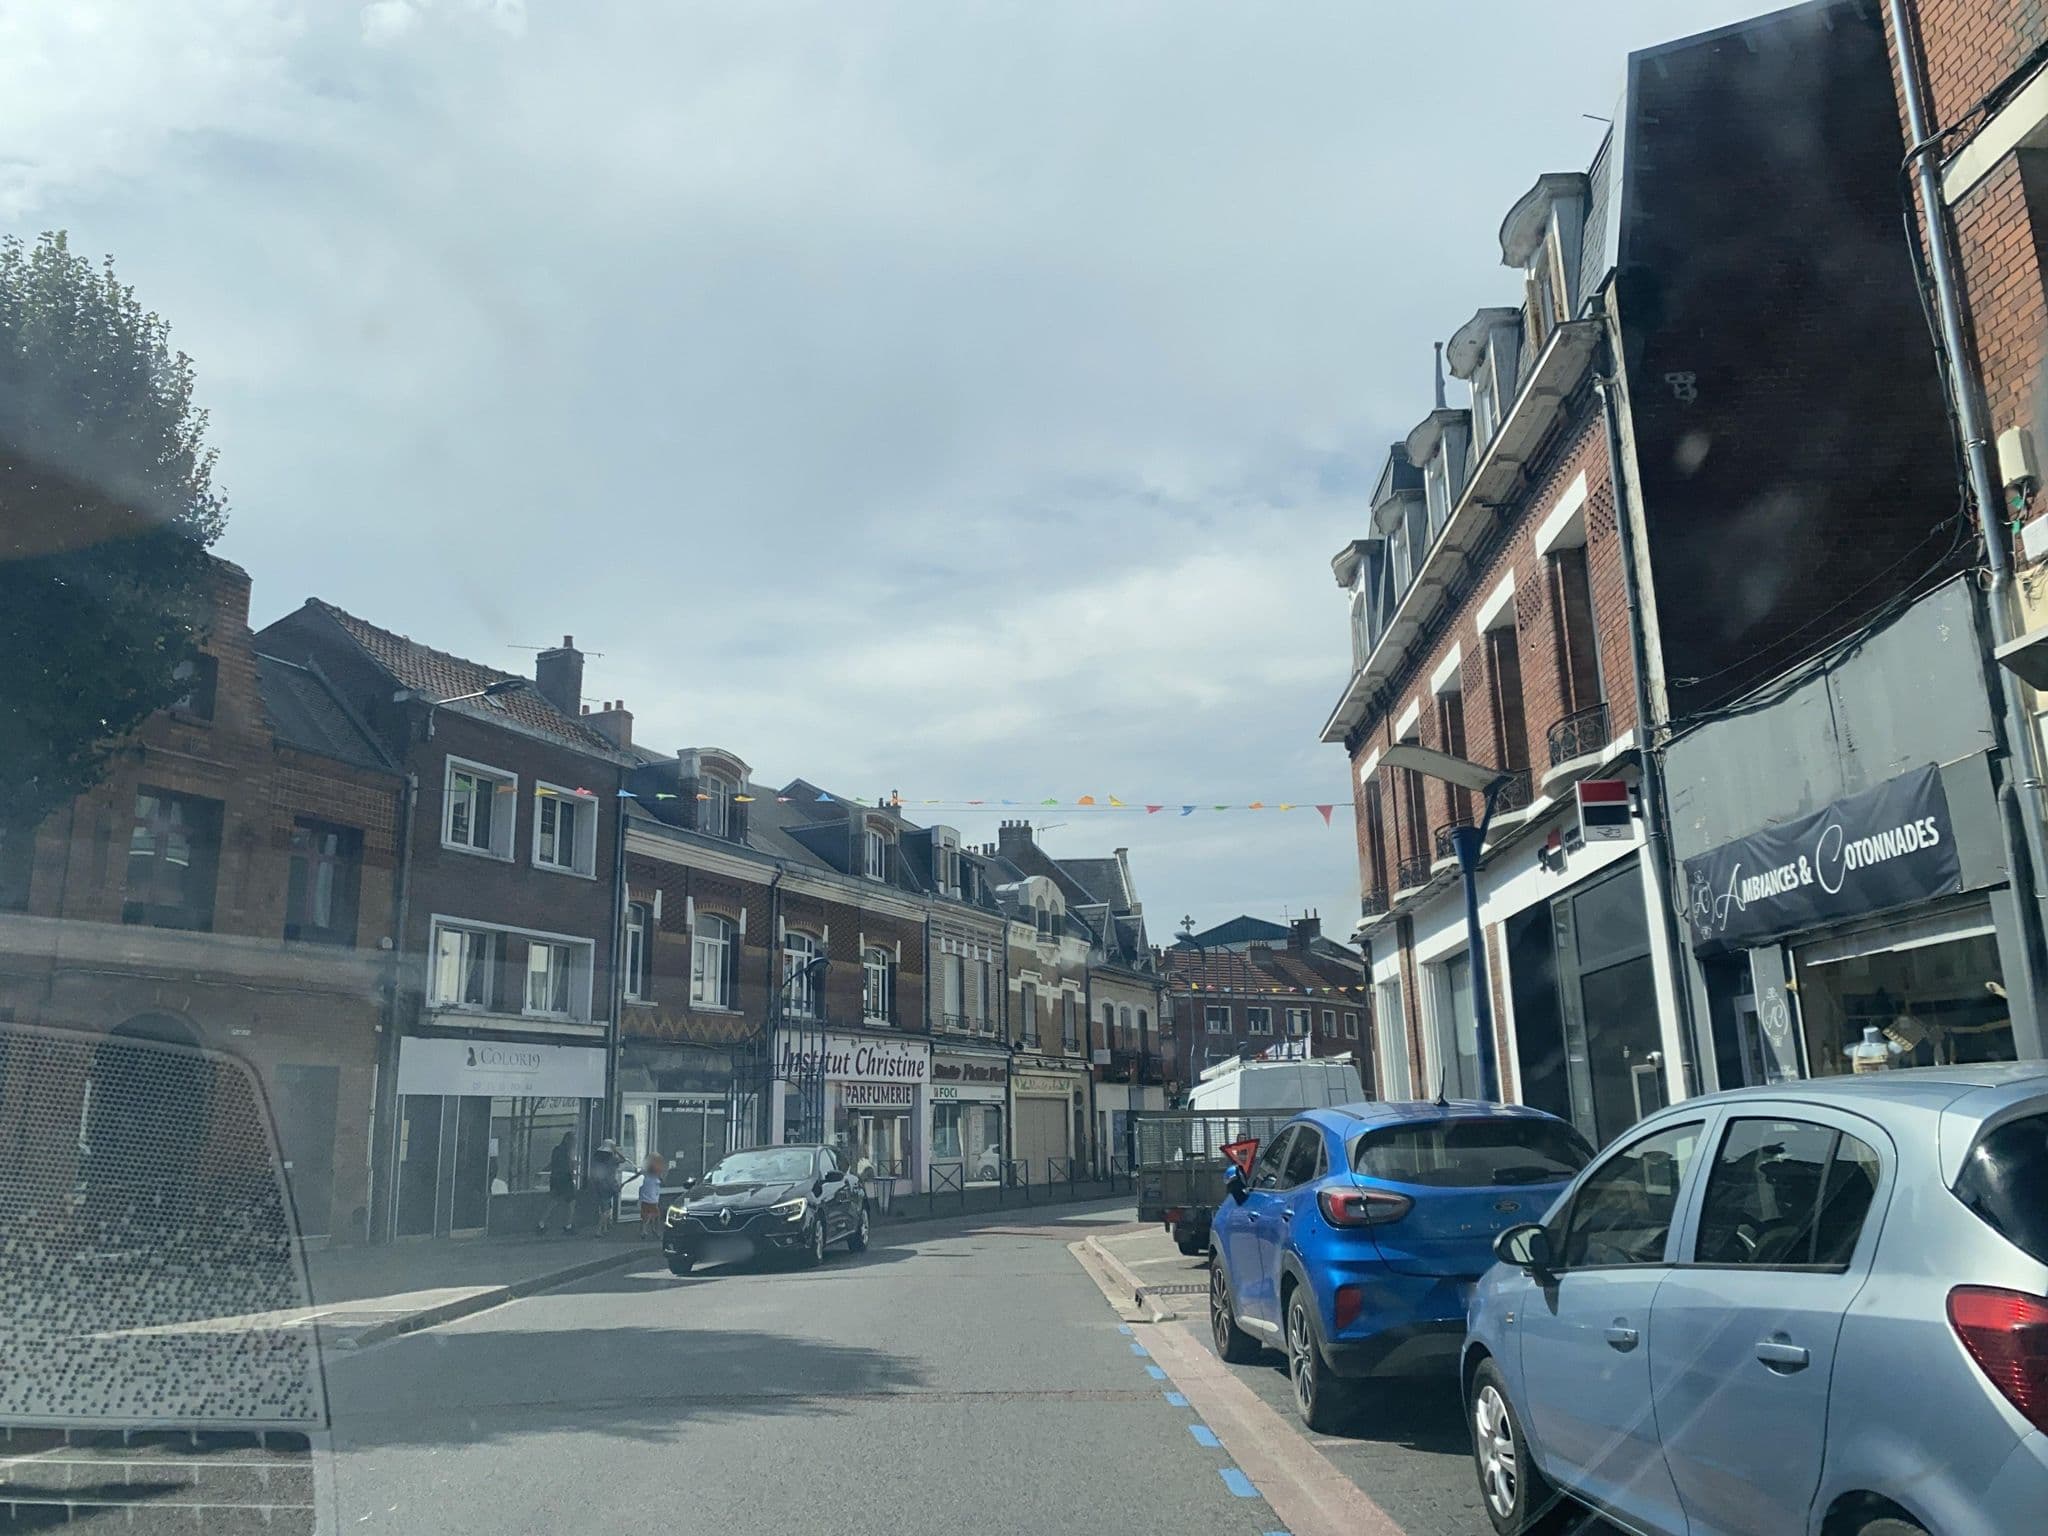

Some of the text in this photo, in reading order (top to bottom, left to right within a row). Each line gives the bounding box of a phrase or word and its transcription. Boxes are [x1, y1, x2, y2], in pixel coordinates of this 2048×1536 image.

[1715, 816, 1940, 932] AMBIANCES & COTONNADES
[855, 1047, 925, 1078] Christine
[845, 1085, 911, 1105] PARFUMERIE
